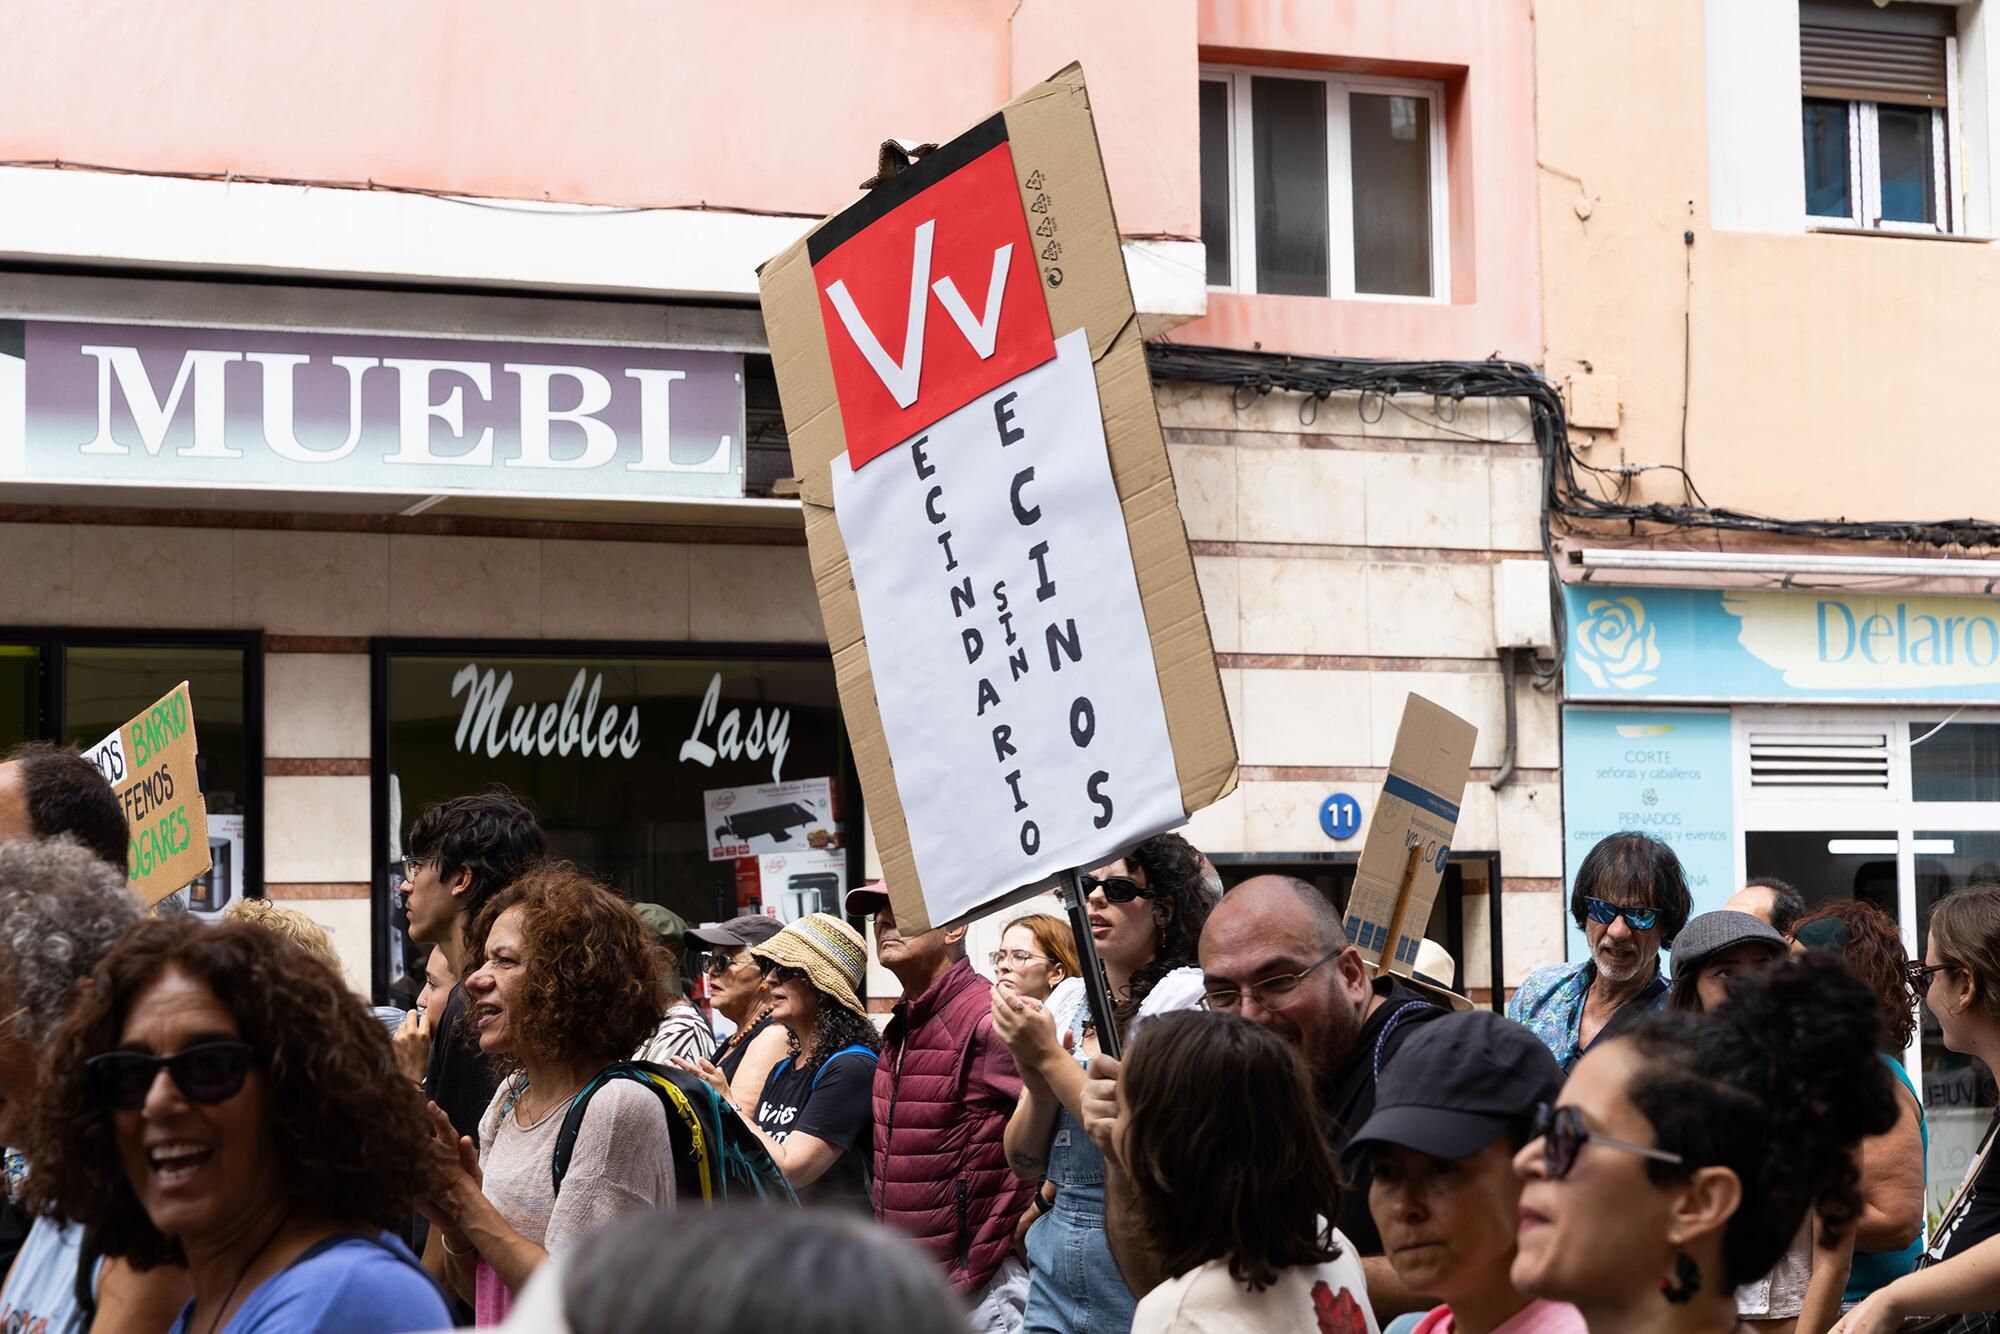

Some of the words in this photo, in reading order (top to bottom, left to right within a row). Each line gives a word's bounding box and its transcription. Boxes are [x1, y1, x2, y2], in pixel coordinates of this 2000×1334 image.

[79, 344, 732, 474] MUEBL
[993, 580, 1029, 682] SIN
[1817, 600, 2000, 667] Delaro
[131, 690, 187, 768] BARRIO
[451, 662, 641, 759] Muebles
[679, 672, 791, 786] Lasy
[1624, 751, 1672, 764] CORTE
[1596, 766, 1637, 779] señoras
[1640, 769, 1646, 781] y
[1649, 766, 1701, 780] caballeros
[128, 805, 190, 880] OGARES
[1327, 803, 1353, 828] 11
[1619, 812, 1682, 825] PEINADOS
[1685, 830, 1727, 841] eventos
